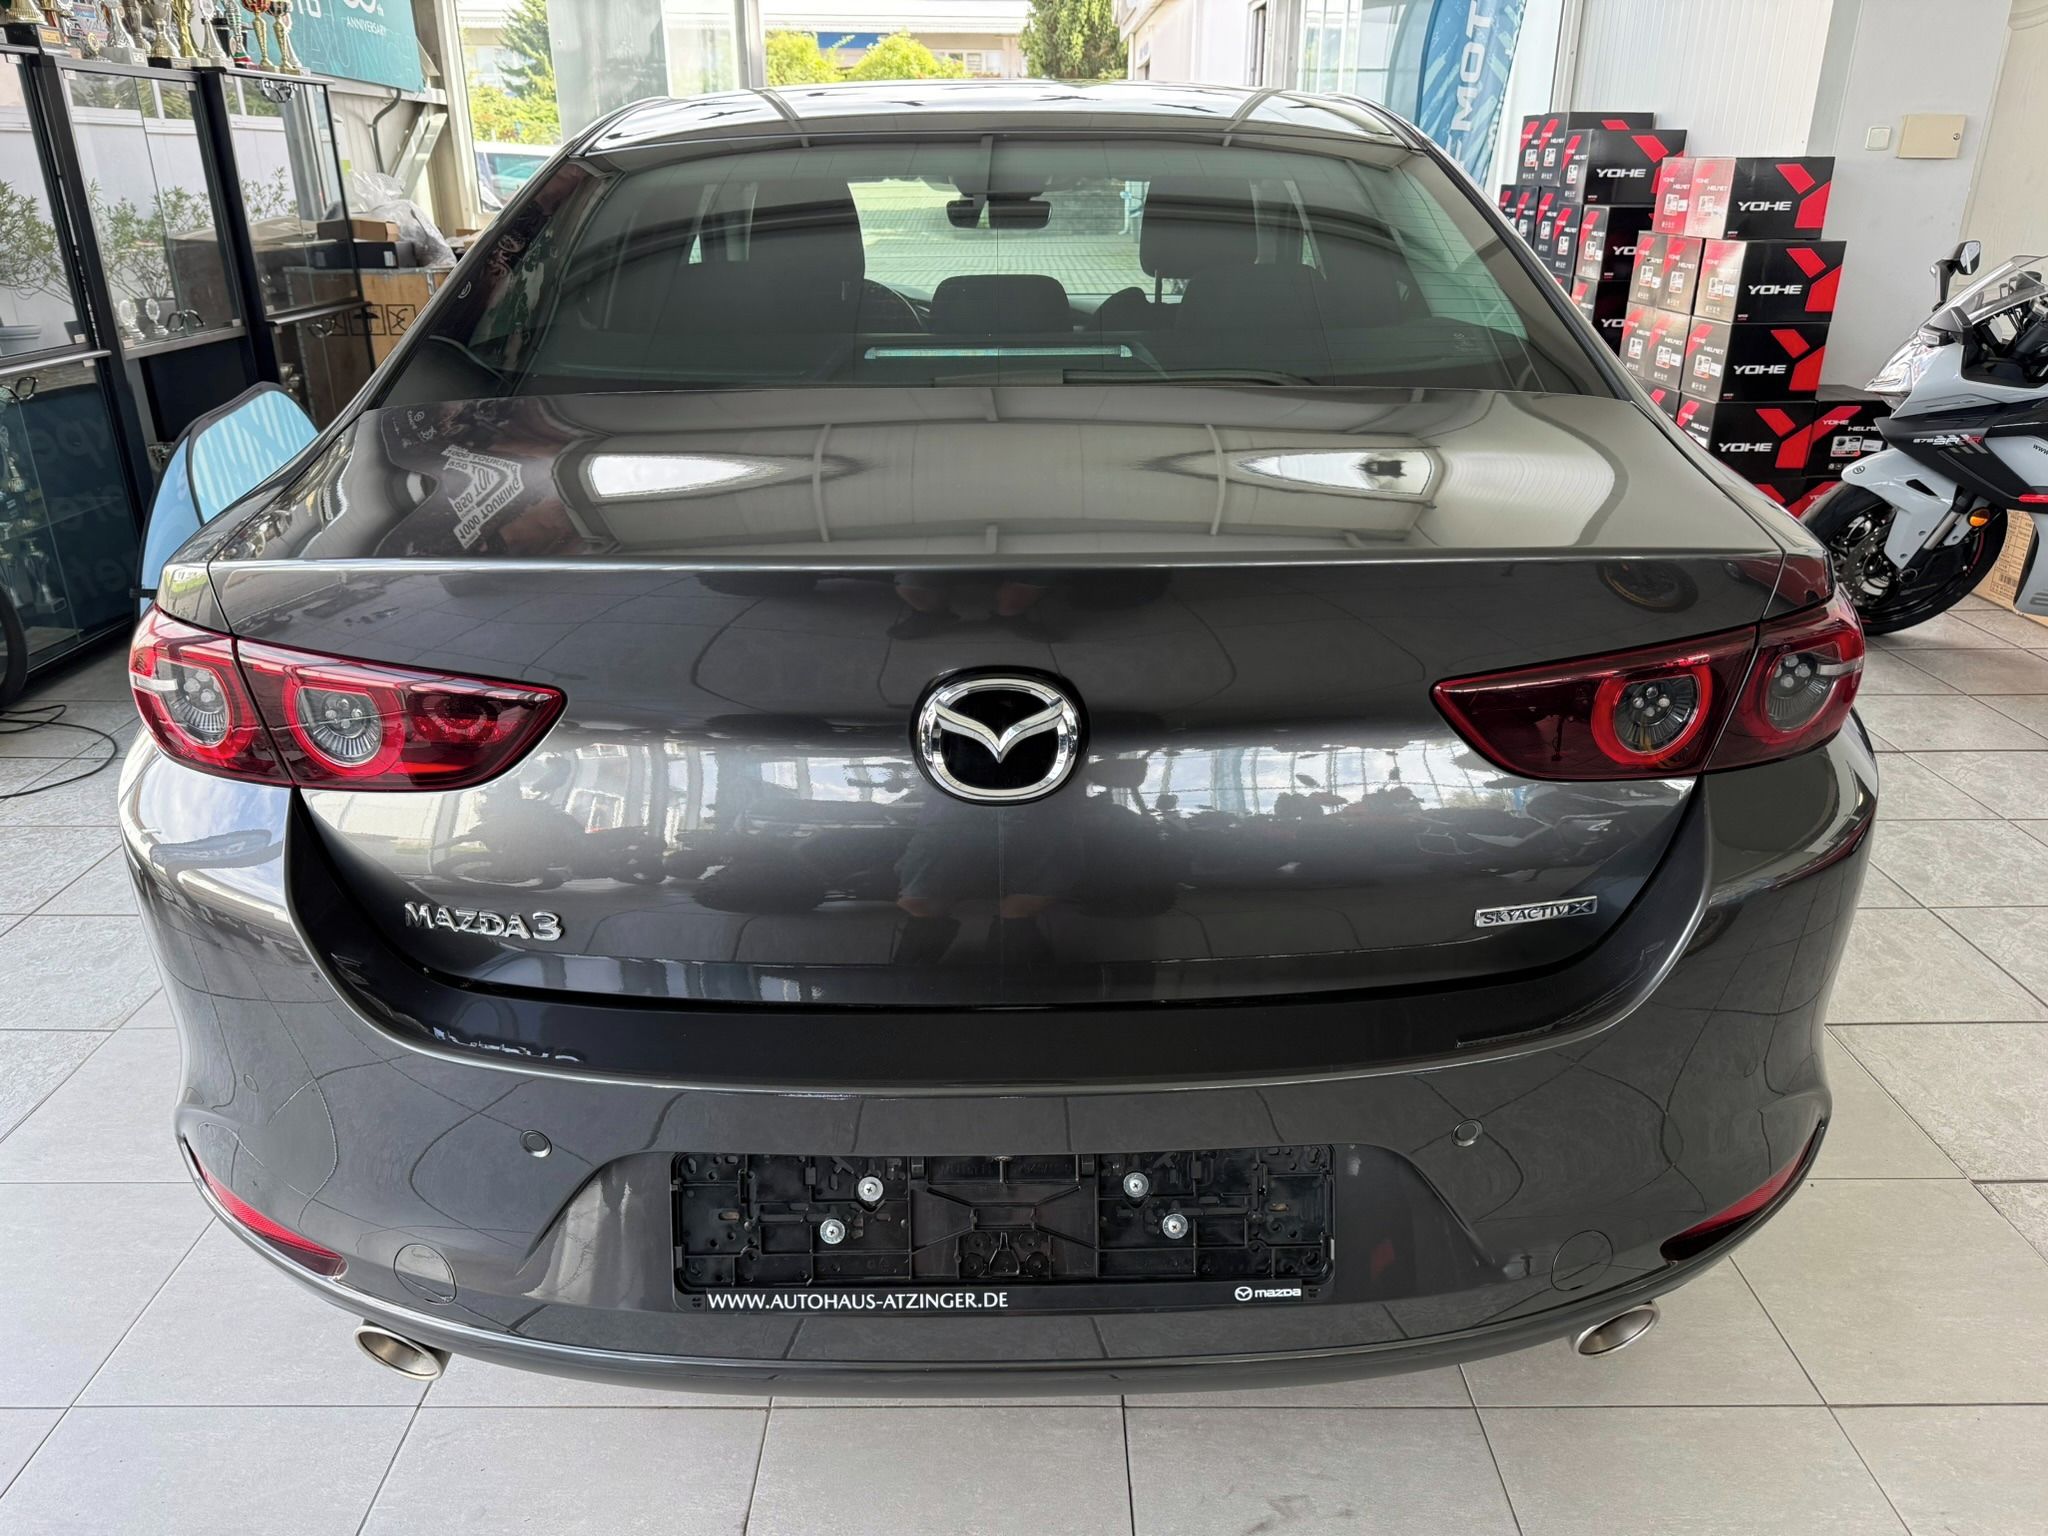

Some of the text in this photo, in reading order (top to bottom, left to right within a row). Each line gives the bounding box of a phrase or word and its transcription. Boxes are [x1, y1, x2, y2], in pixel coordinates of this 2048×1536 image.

[346, 15, 387, 36] ANNIVERSARY
[1595, 168, 1647, 178] YOHE
[1737, 201, 1793, 212] YOHE
[1612, 246, 1636, 256] YO
[1747, 285, 1803, 295] YOHE
[1601, 319, 1625, 328] YO
[1733, 364, 1787, 375] YOHE
[1718, 442, 1773, 453] YOHE
[1482, 903, 1568, 925] SKYACTIV
[707, 1292, 1008, 1310] WWW.AUTOHAUS-ATZINGER.DE
